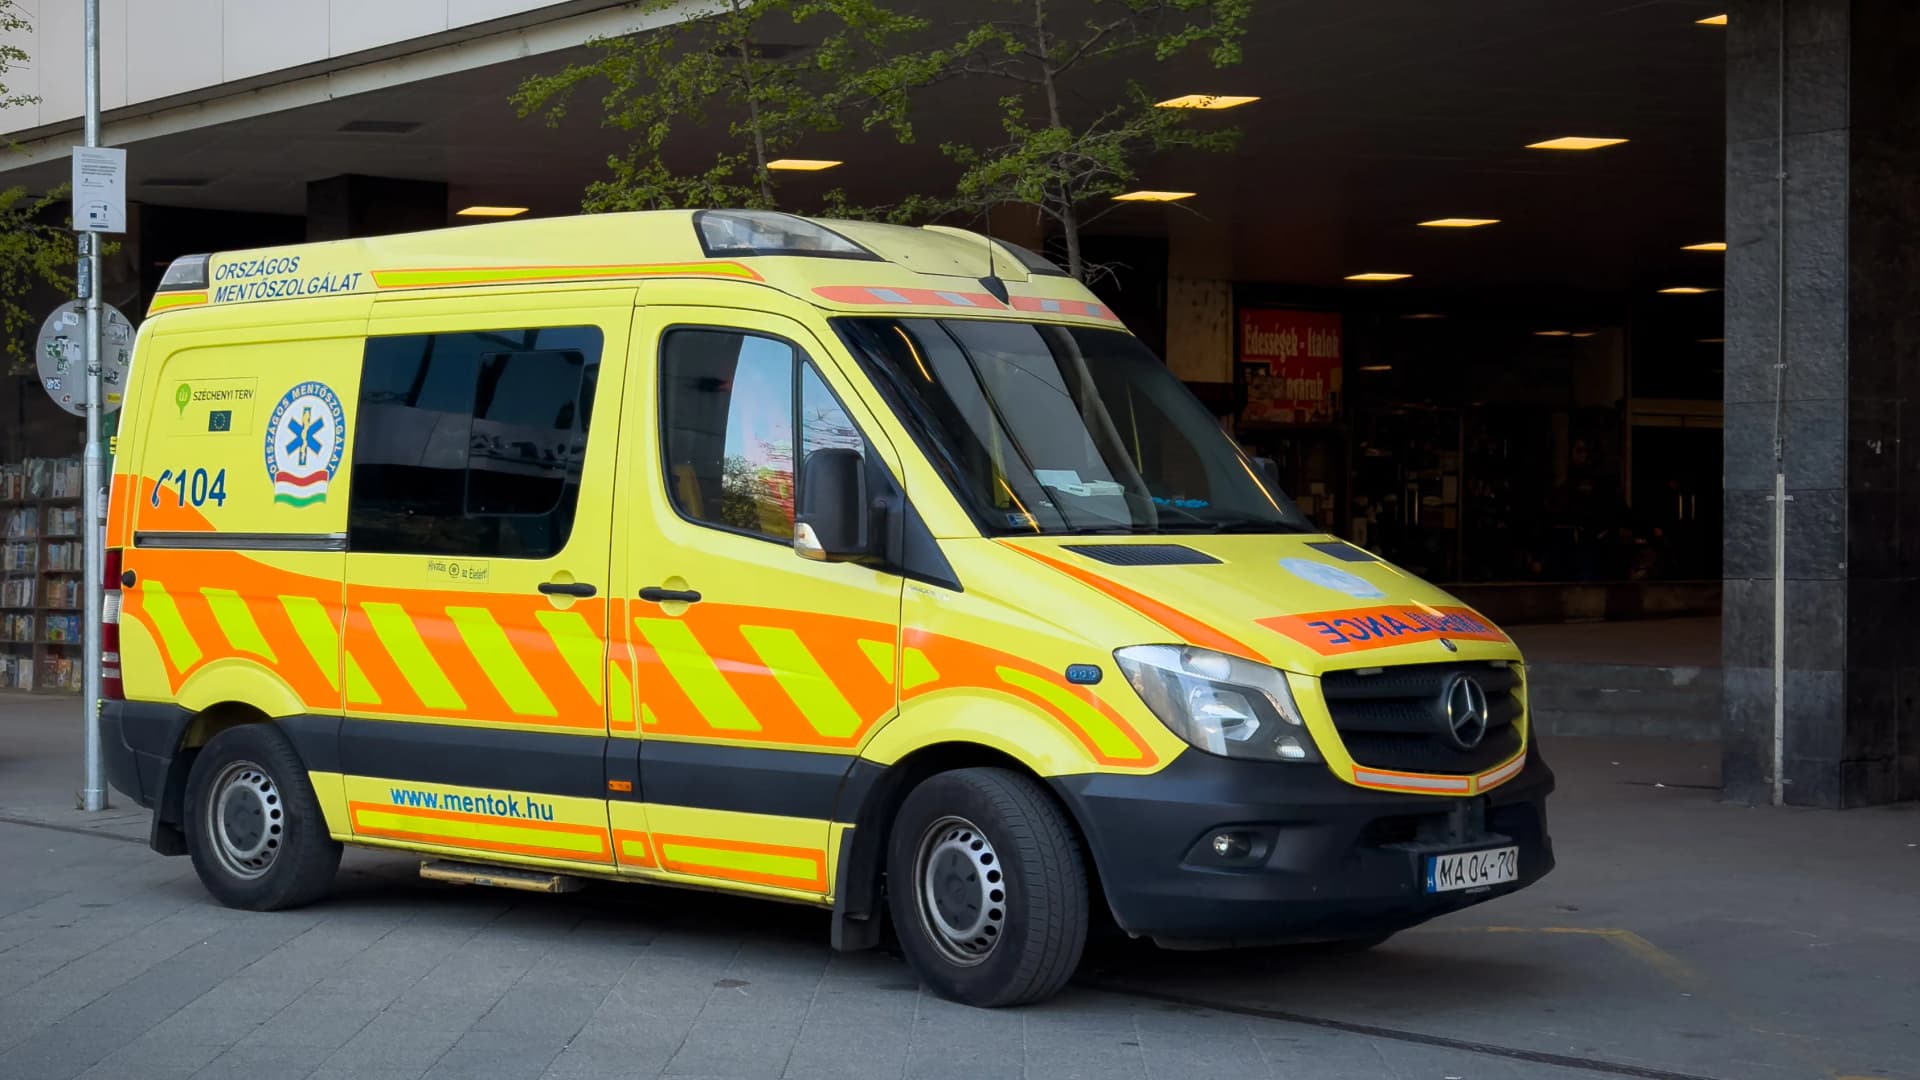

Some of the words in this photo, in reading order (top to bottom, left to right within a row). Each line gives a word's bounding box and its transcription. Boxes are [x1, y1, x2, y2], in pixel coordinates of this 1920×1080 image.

[215, 256, 300, 281] ORSZÁGOS
[214, 272, 361, 303] MENTŐSZOLGÁLAT
[235, 389, 254, 400] TERV
[266, 397, 290, 474] ORSZÁGOS
[291, 383, 345, 472] MENTŐSZOLGÁLAT
[175, 467, 226, 507] 104
[390, 788, 554, 821] www.mentok.hu
